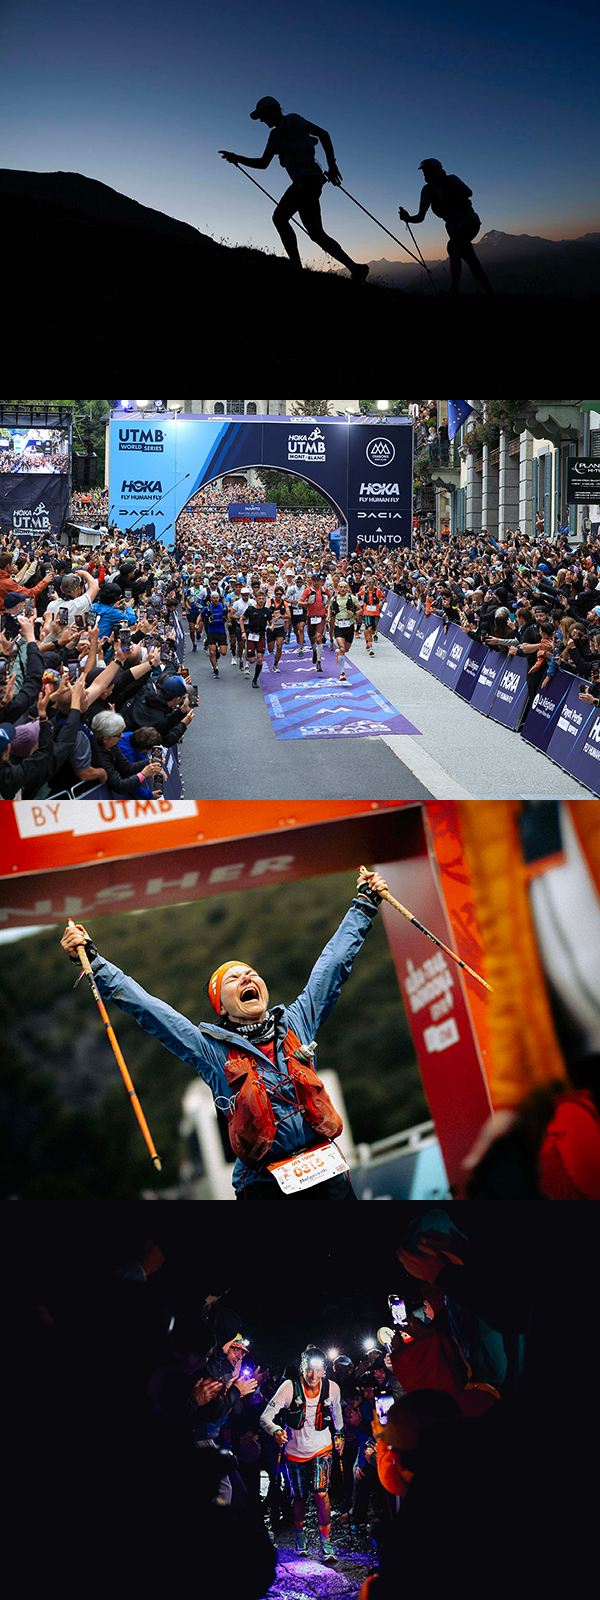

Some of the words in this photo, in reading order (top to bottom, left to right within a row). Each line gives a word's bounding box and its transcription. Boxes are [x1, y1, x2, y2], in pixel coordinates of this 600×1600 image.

[118, 429, 164, 442] UTMB
[288, 442, 326, 453] UTMB
[121, 480, 163, 493] HOKA
[359, 483, 400, 496] HOKA
[13, 516, 50, 528] UTMB
[356, 534, 402, 544] SUUNTO
[500, 670, 521, 694] HOKA
[31, 803, 60, 827] BY
[97, 800, 173, 822] UTMB
